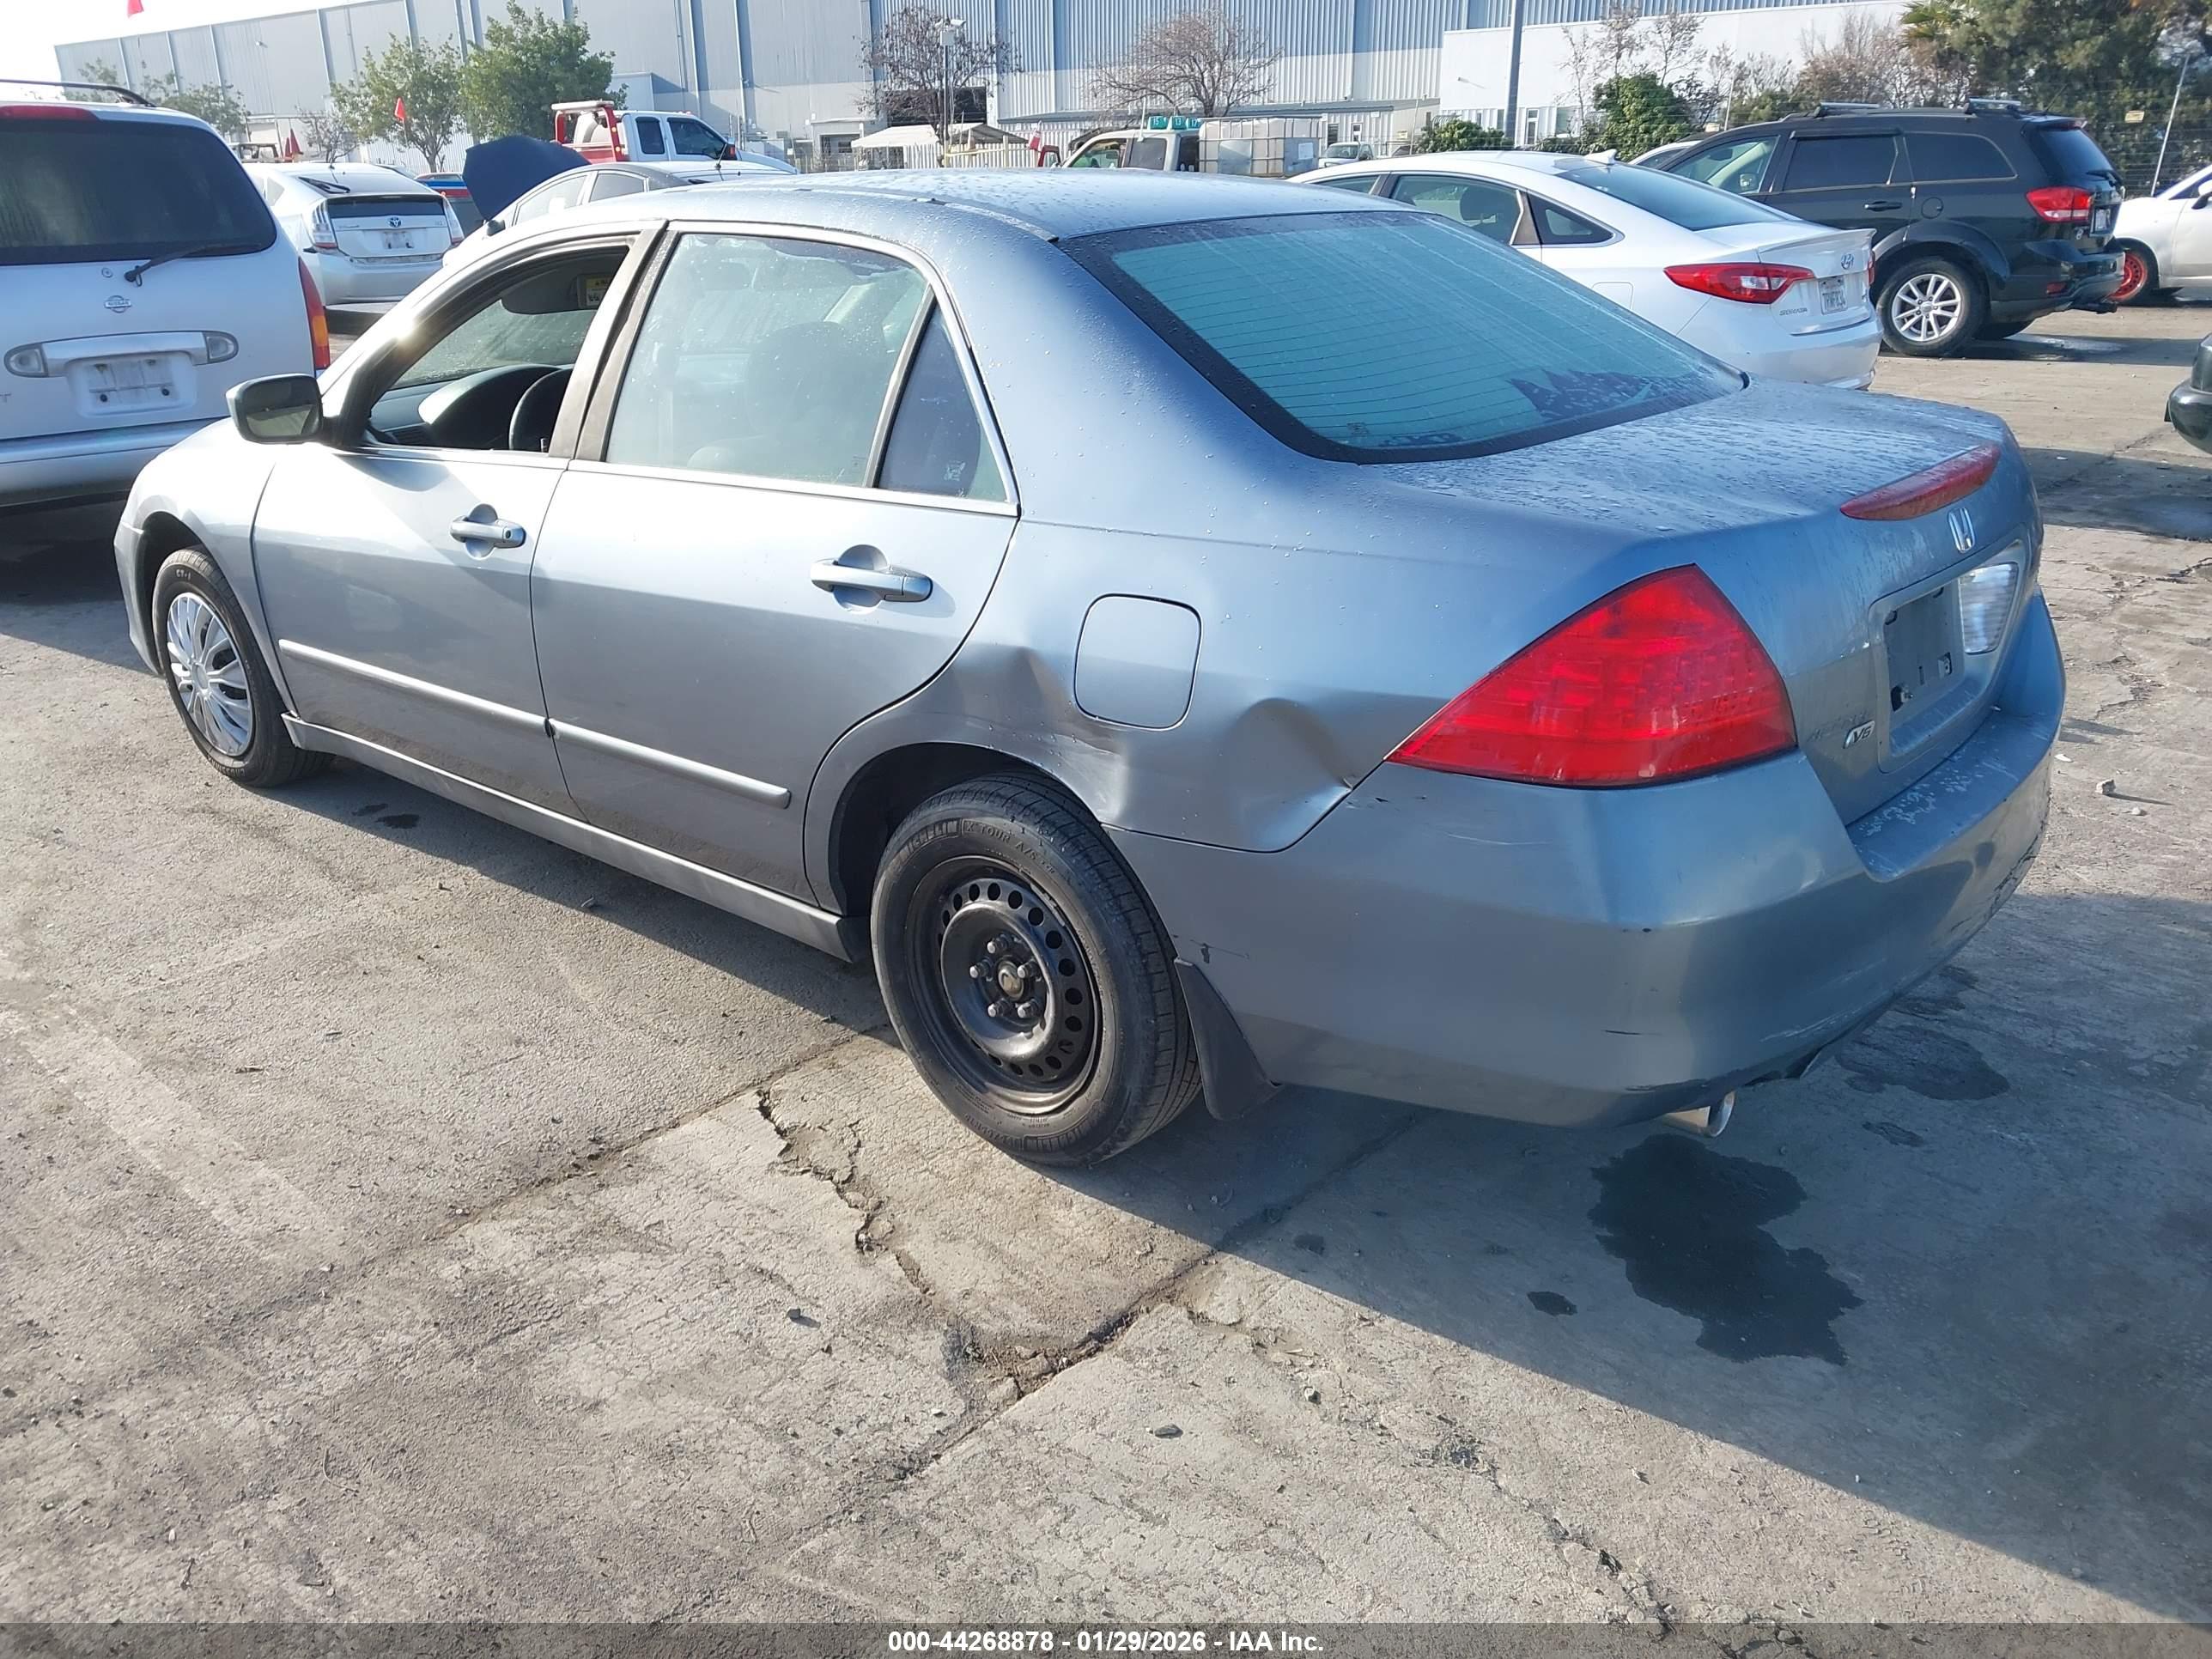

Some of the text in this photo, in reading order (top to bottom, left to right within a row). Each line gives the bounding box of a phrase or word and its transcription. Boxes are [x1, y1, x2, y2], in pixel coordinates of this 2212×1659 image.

[1779, 307, 1808, 316] SONATA
[1853, 725, 1872, 744] V6
[980, 824, 1011, 845] TOUR
